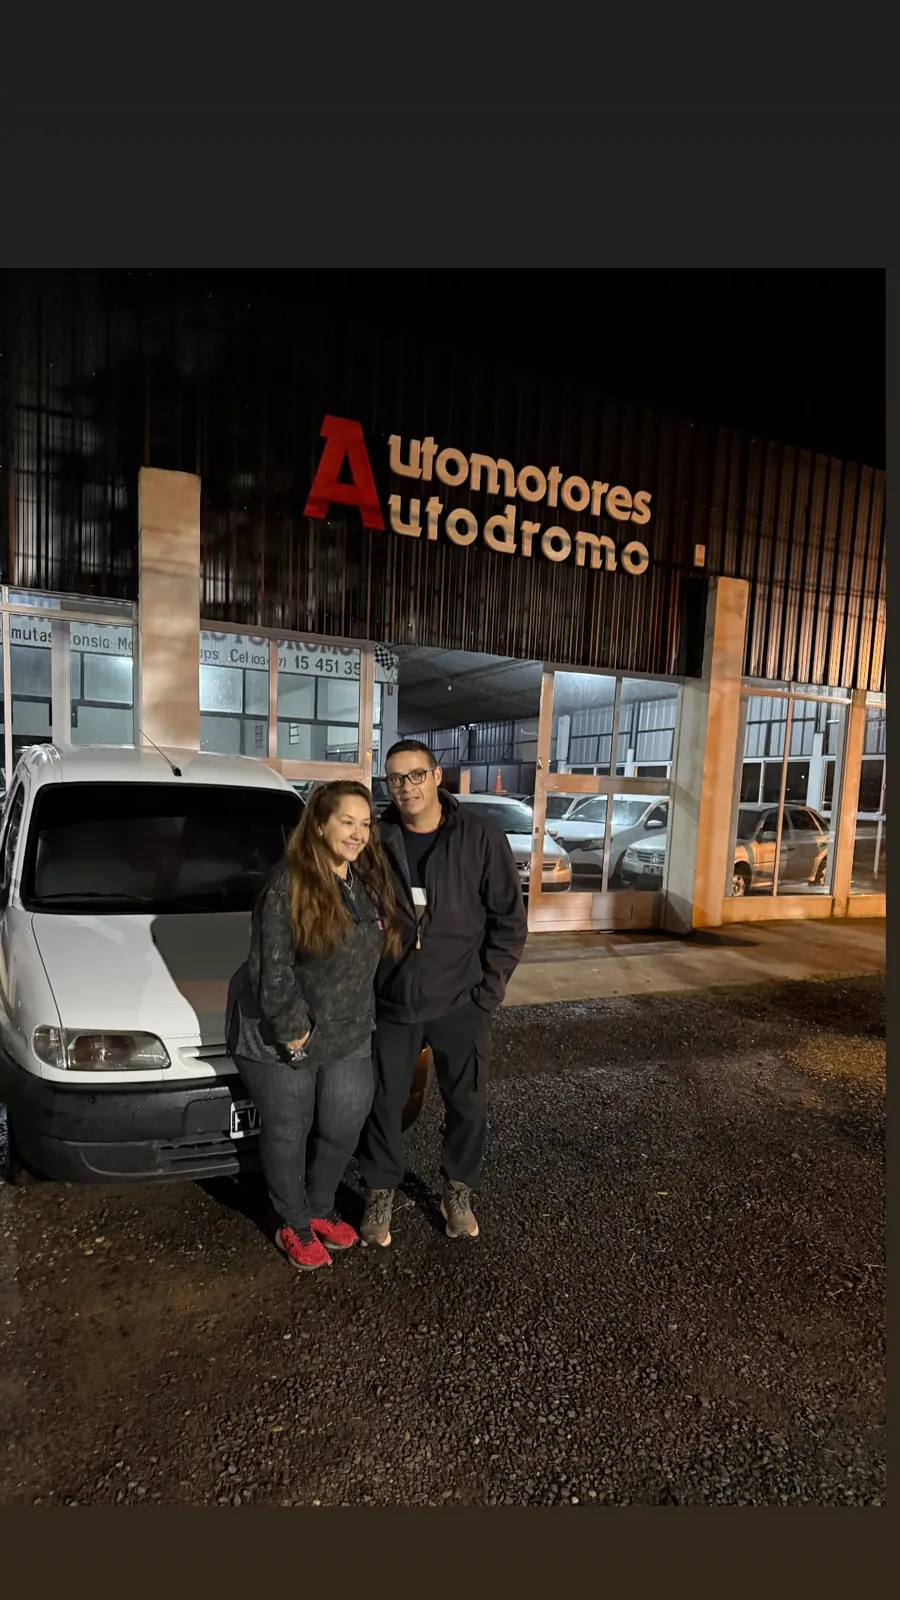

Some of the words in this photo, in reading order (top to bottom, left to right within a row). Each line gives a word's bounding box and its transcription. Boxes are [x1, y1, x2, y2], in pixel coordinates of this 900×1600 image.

[230, 648, 248, 663] Cel
[294, 655, 309, 670] 15
[315, 658, 338, 673] 451
[234, 1108, 261, 1132] FV
